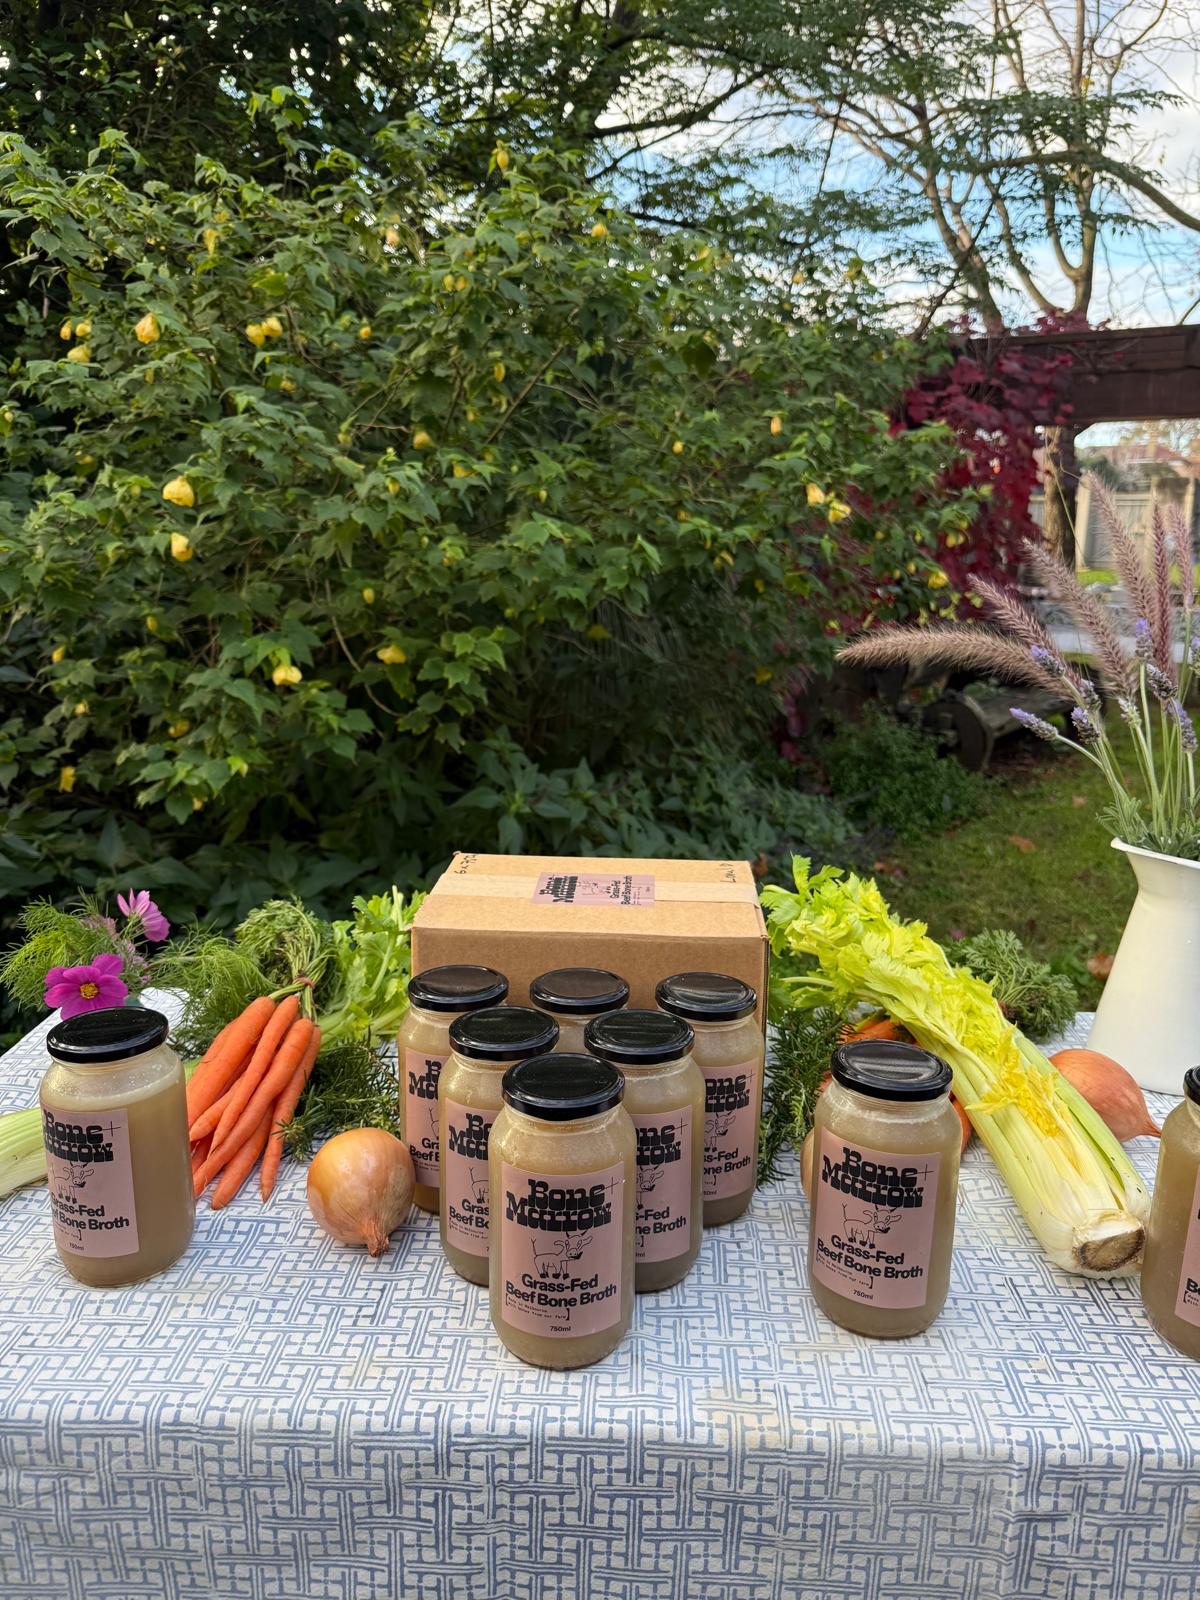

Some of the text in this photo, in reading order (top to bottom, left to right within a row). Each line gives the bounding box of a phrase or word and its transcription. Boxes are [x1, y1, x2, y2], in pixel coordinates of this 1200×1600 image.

[44, 1109, 103, 1144] Bone
[409, 1144, 434, 1161] Beef
[724, 1156, 751, 1172] Broth
[843, 1147, 917, 1187] Bone
[822, 1154, 924, 1208] Marrow
[528, 1179, 605, 1211] Bone
[59, 1211, 86, 1229] Bone
[88, 1216, 129, 1230] Broth
[450, 1206, 474, 1226] Beef
[506, 1190, 612, 1231] Marrow
[653, 1216, 686, 1233] Broth
[818, 1238, 843, 1263] Beef
[844, 1257, 881, 1276] Bone
[884, 1266, 923, 1279] Broth
[831, 1234, 904, 1264] Grass-Fed
[506, 1281, 617, 1307] Beef Bone Broth
[522, 1274, 598, 1292] Grass-Fed
[853, 1289, 874, 1300] 750ml
